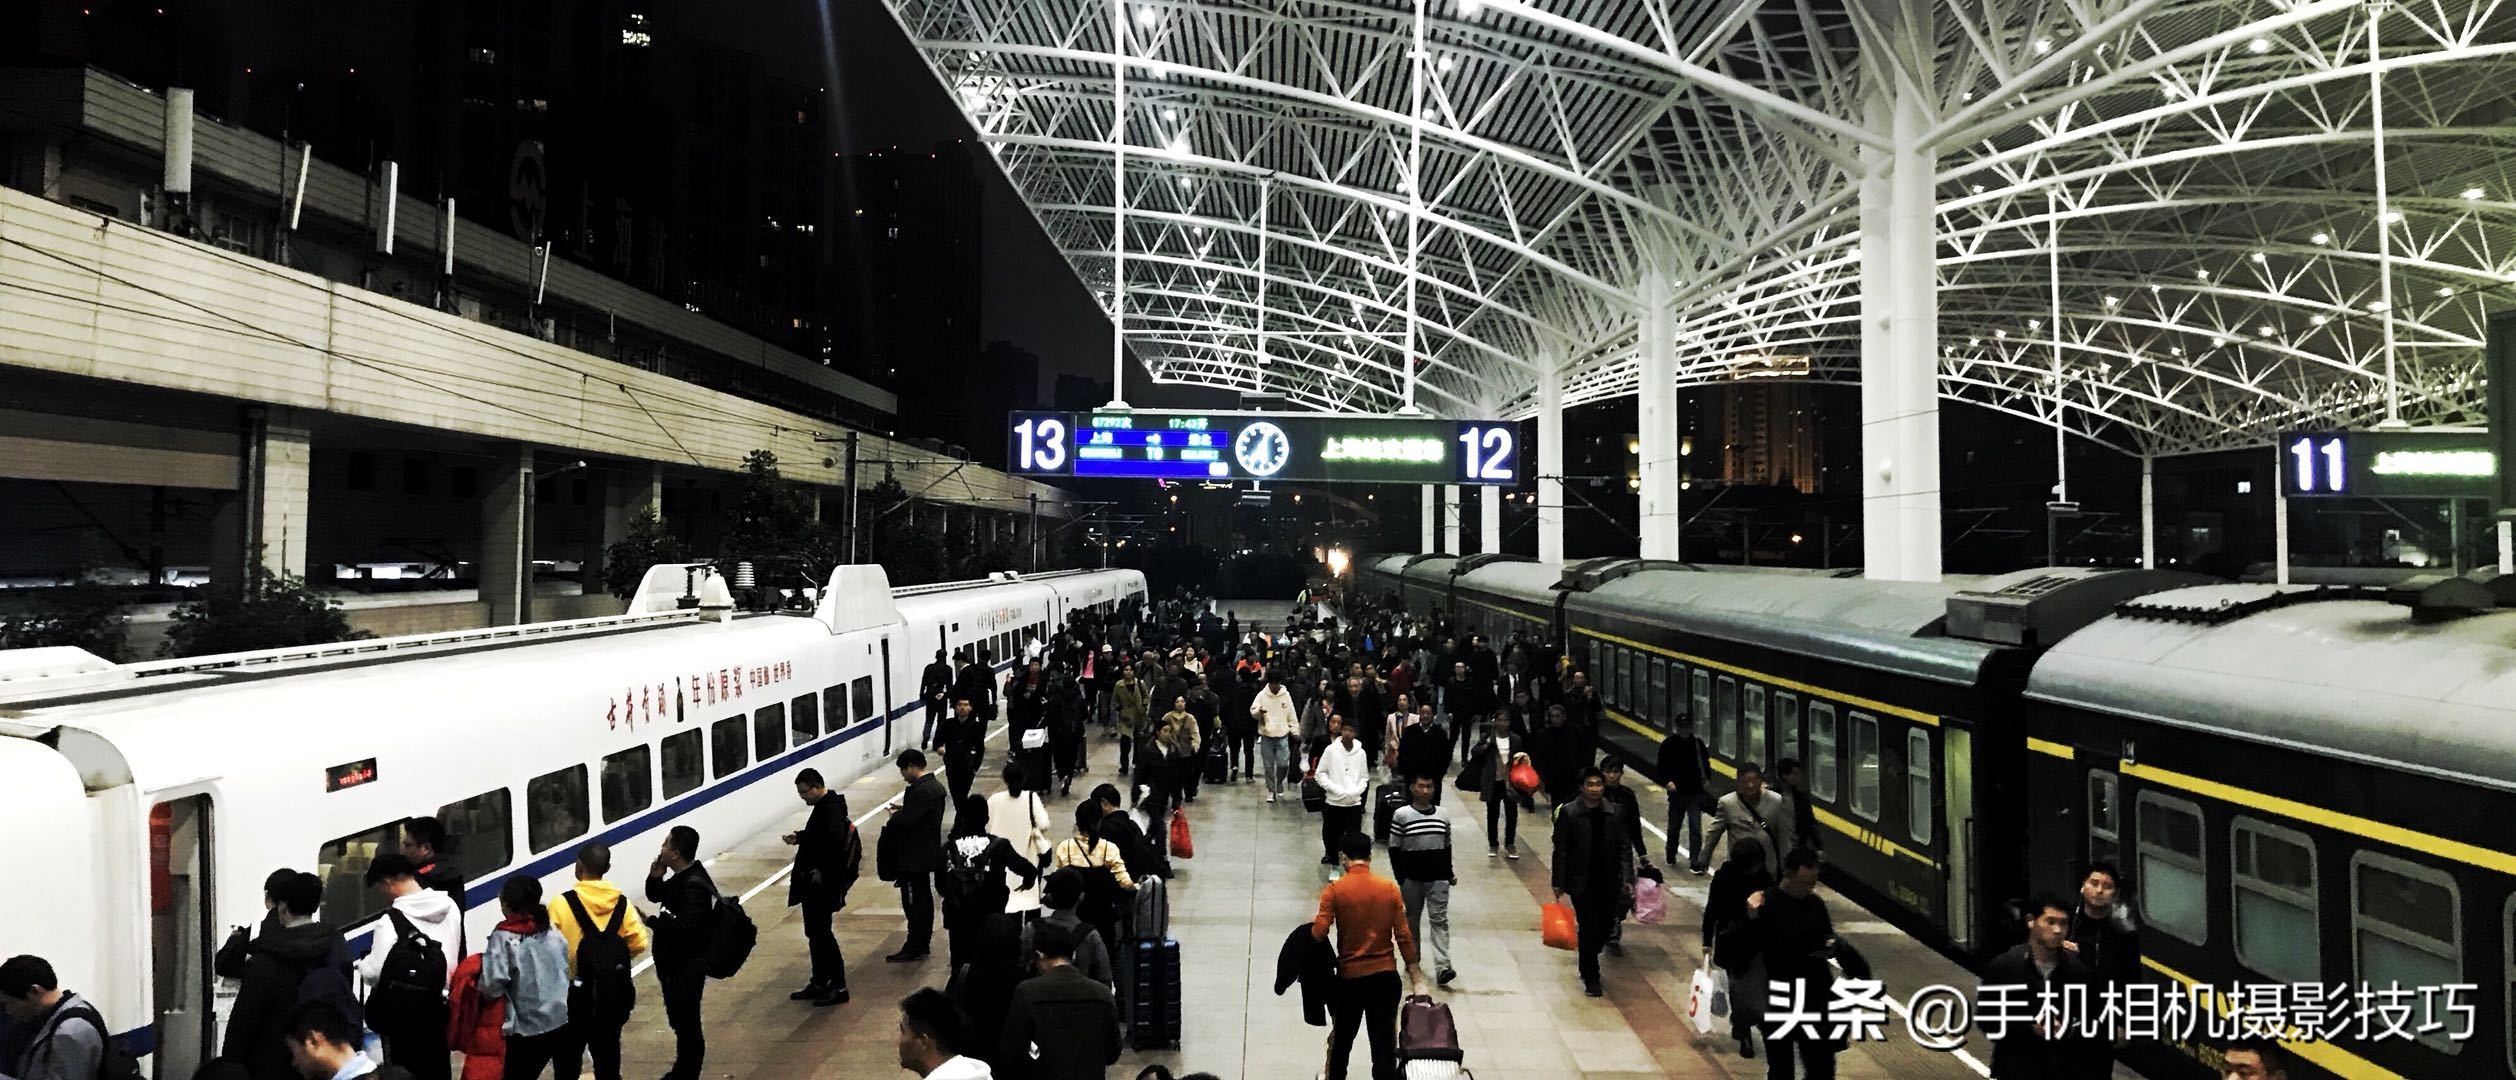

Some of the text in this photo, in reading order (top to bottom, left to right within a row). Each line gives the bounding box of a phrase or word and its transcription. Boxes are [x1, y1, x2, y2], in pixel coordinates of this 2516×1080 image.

[1014, 418, 1066, 470] 13
[1459, 426, 1513, 479] 12
[2291, 438, 2343, 491] 11
